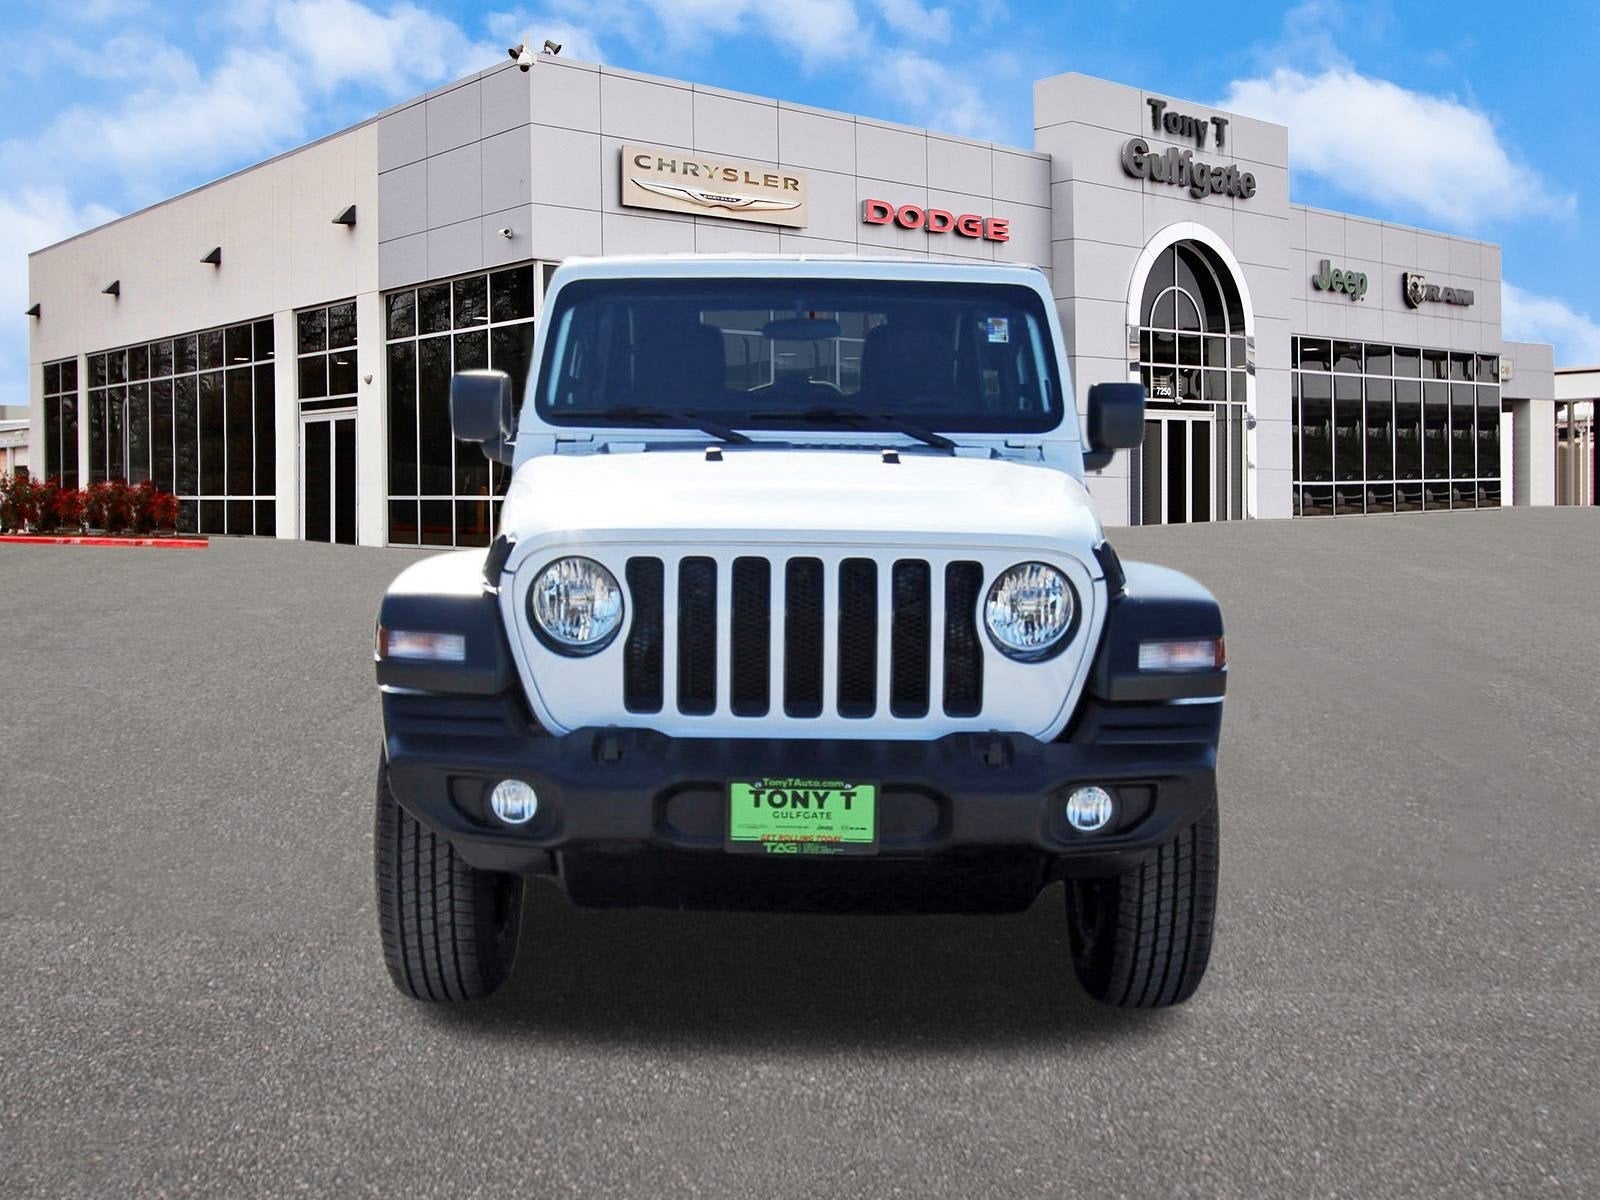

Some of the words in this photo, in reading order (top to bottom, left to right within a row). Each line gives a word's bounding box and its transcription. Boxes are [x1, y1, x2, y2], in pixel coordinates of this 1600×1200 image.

[1146, 97, 1208, 147] Tony
[1211, 117, 1229, 147] T
[634, 154, 800, 192] CHRYSLER
[1121, 137, 1257, 199] Gulfgate
[862, 198, 1010, 242] DODGE
[1312, 259, 1368, 301] Jeep
[1425, 284, 1474, 306] RAM
[762, 778, 844, 788] TonyTAuto.com
[749, 790, 830, 809] TONY
[840, 791, 857, 810] T
[772, 811, 833, 820] GULFGATE
[763, 842, 798, 853] TAG
